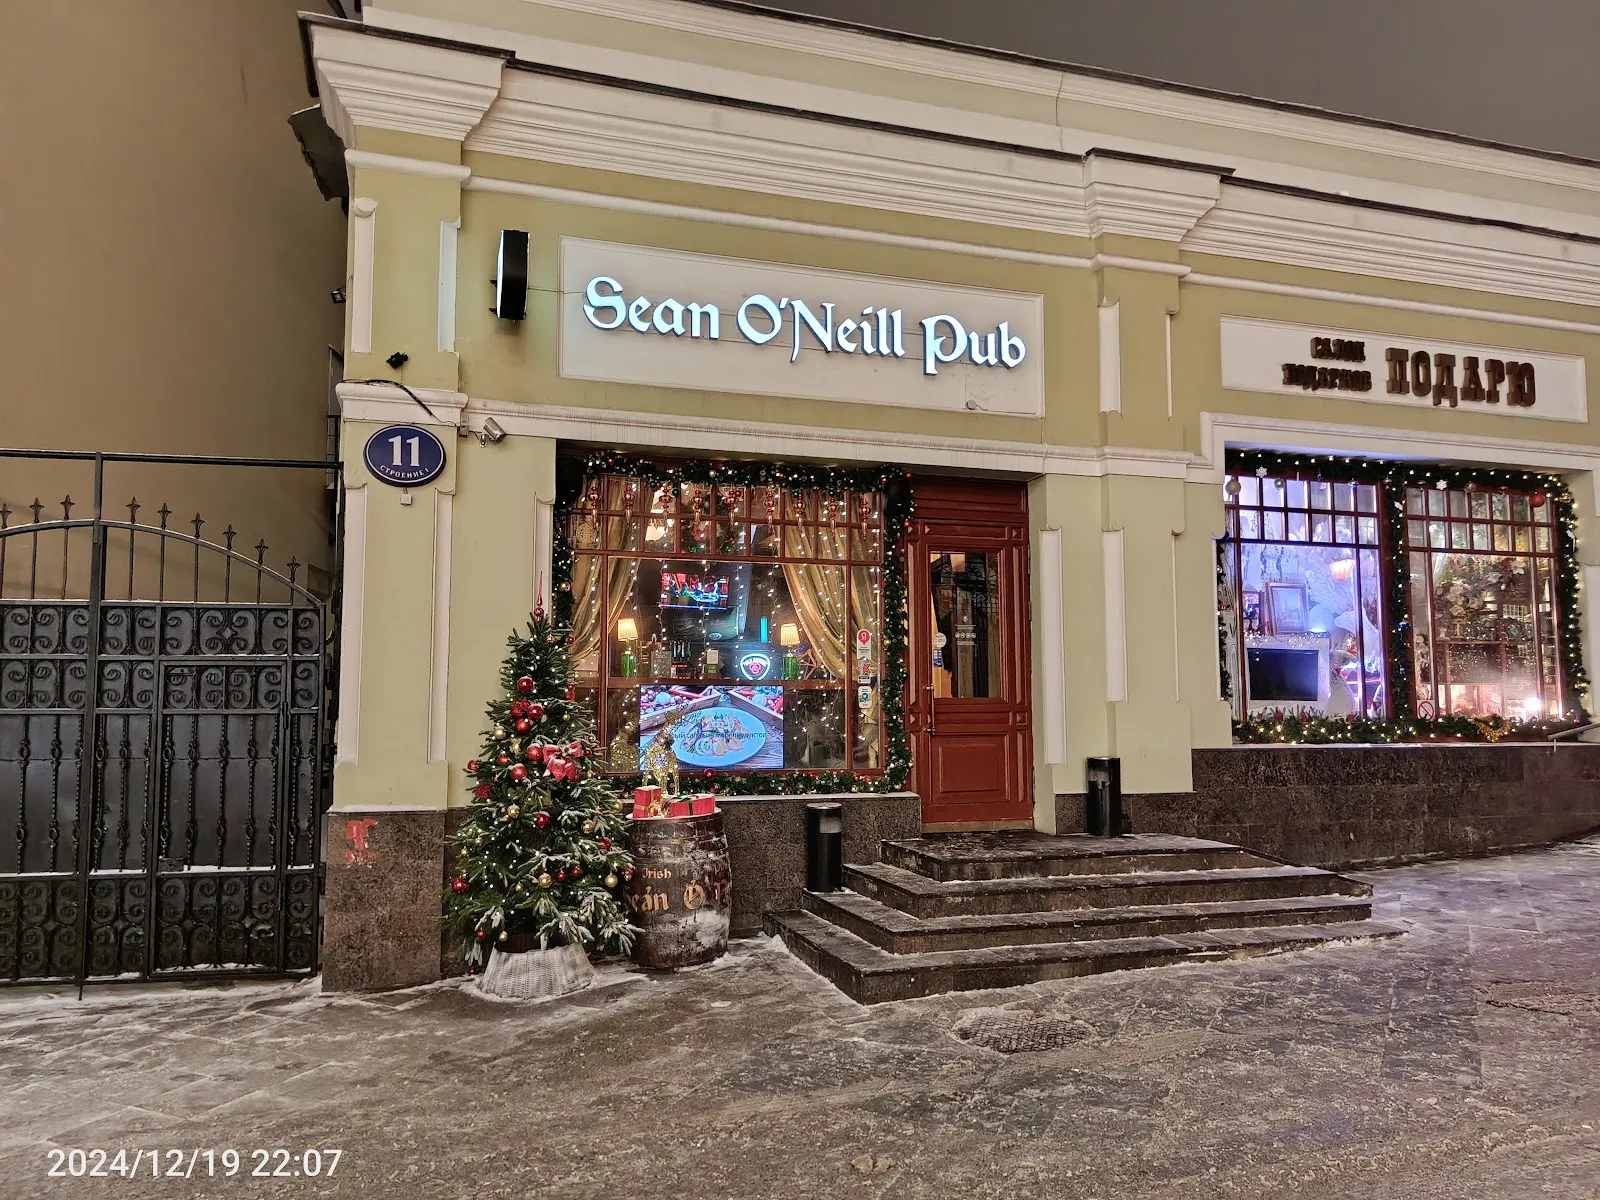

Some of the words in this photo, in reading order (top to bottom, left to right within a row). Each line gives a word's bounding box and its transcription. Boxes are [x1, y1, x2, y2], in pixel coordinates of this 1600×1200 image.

[582, 276, 719, 340] Sean
[736, 294, 906, 363] O'Neill
[919, 313, 1026, 376] Pub
[1385, 346, 1536, 408] ПОДАРЮ
[388, 435, 420, 467] 11
[380, 464, 424, 479] СТРОЕНИЕ
[642, 866, 672, 879] Irish
